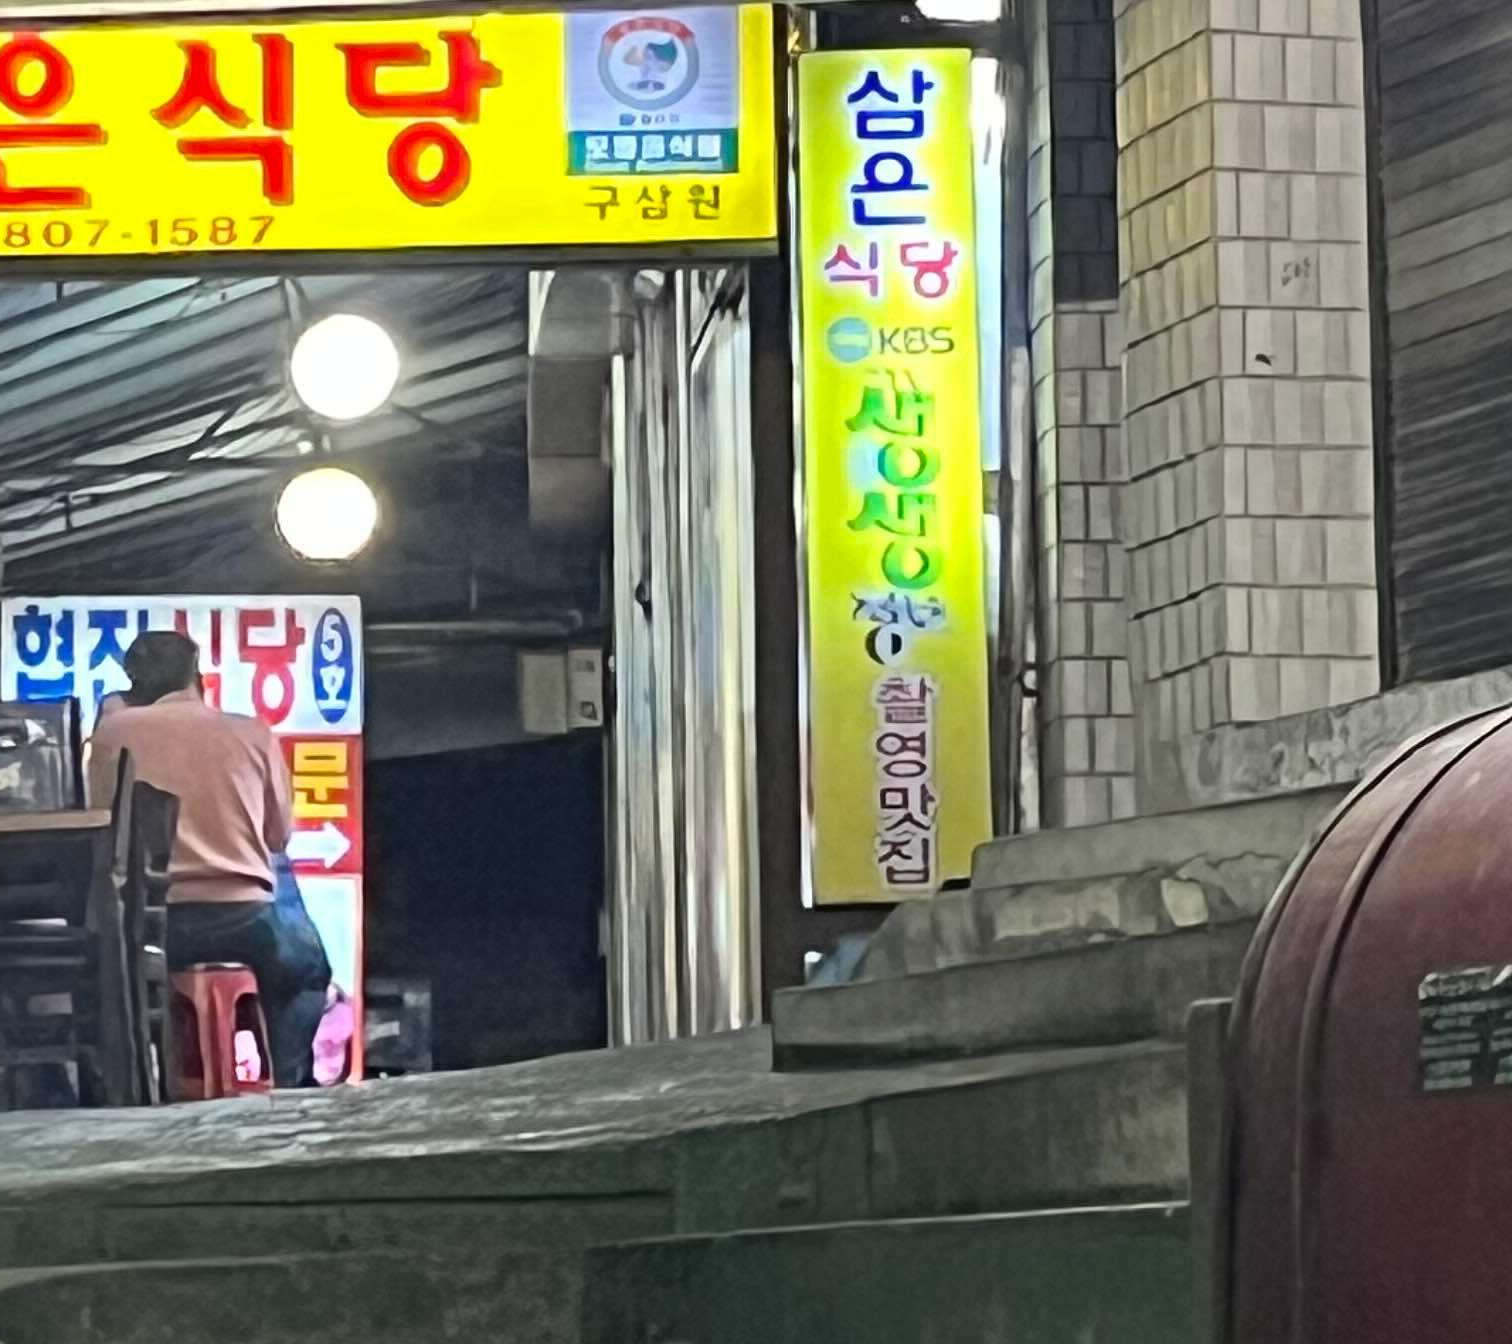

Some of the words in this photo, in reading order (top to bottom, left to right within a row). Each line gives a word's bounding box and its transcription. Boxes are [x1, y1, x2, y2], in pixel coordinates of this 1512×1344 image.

[846, 69, 936, 226] 삼은
[584, 183, 722, 221] 구삼원
[2, 215, 276, 248] 807-1587
[823, 240, 959, 299] 식당
[876, 325, 956, 355] KBS
